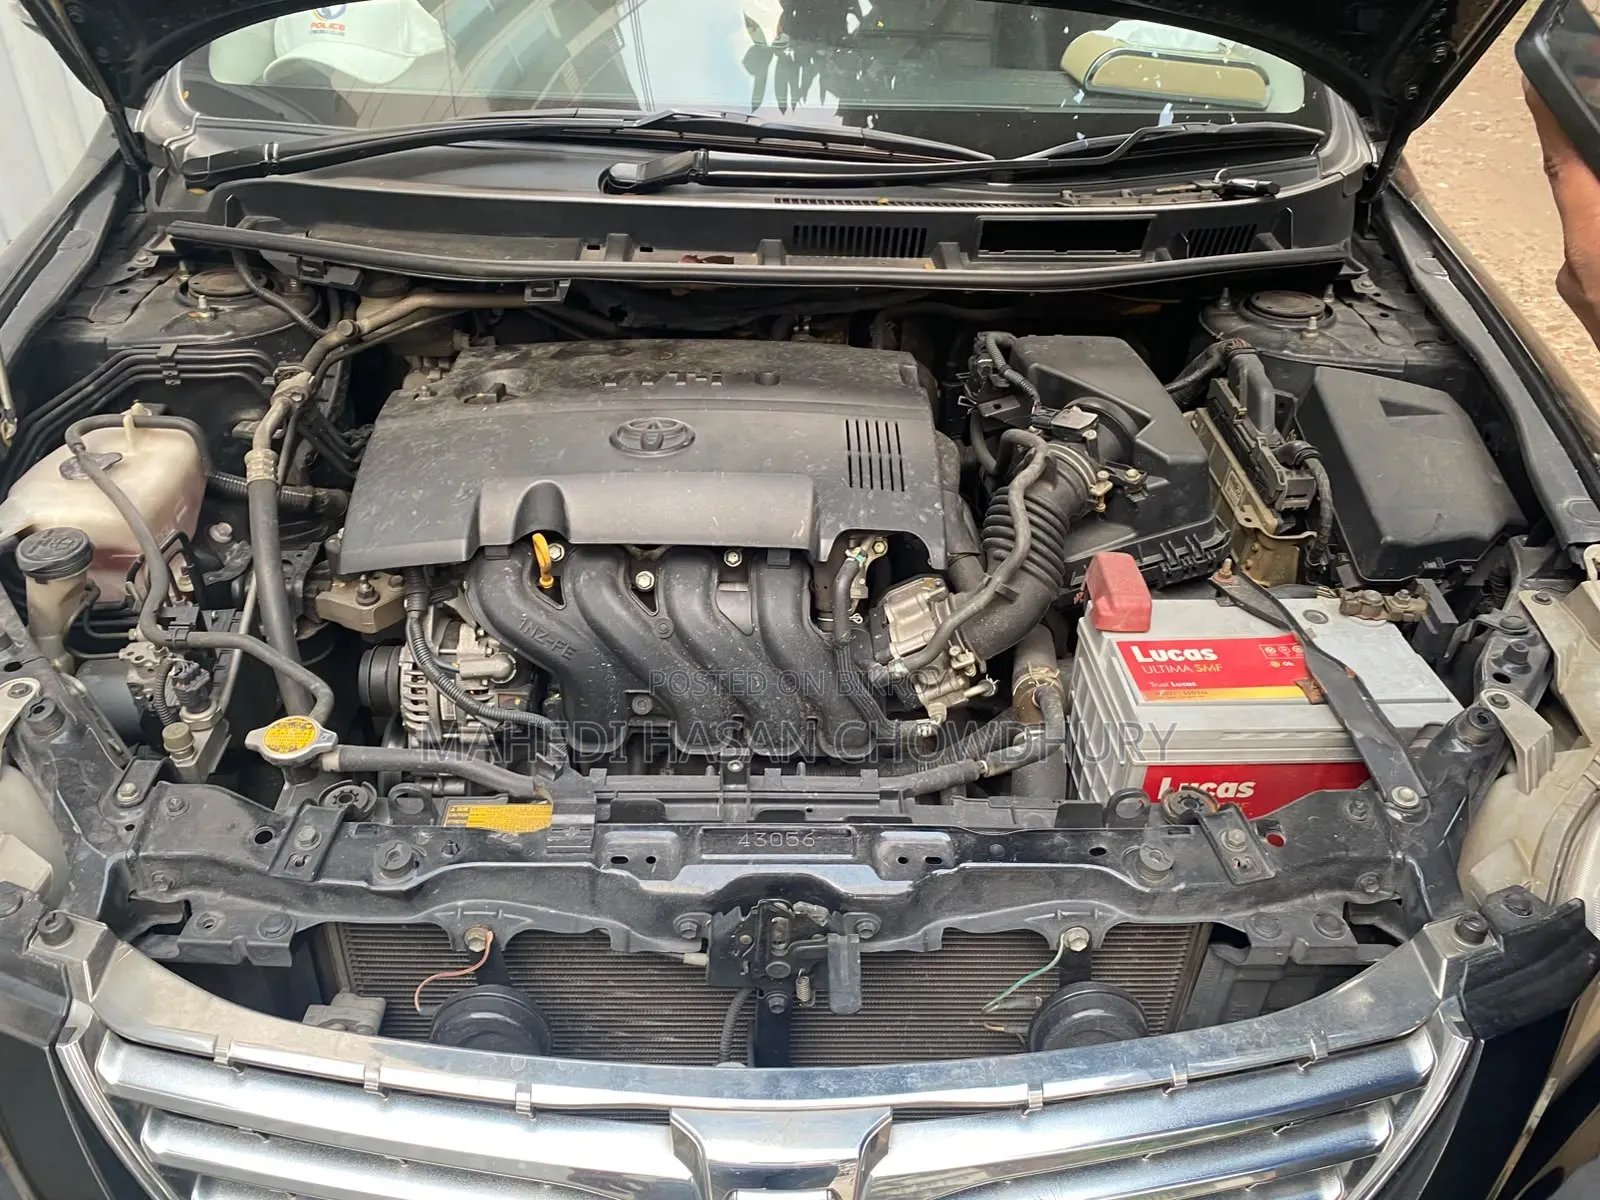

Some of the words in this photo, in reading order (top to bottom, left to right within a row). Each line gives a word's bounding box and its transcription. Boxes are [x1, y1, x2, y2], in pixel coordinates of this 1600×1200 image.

[310, 22, 345, 31] POLICE
[519, 616, 577, 661] 1NZ-FE
[1131, 645, 1218, 663] Lucas
[1141, 664, 1194, 674] ULTIMA
[1194, 663, 1223, 673] SMF
[737, 830, 816, 847] 43056
